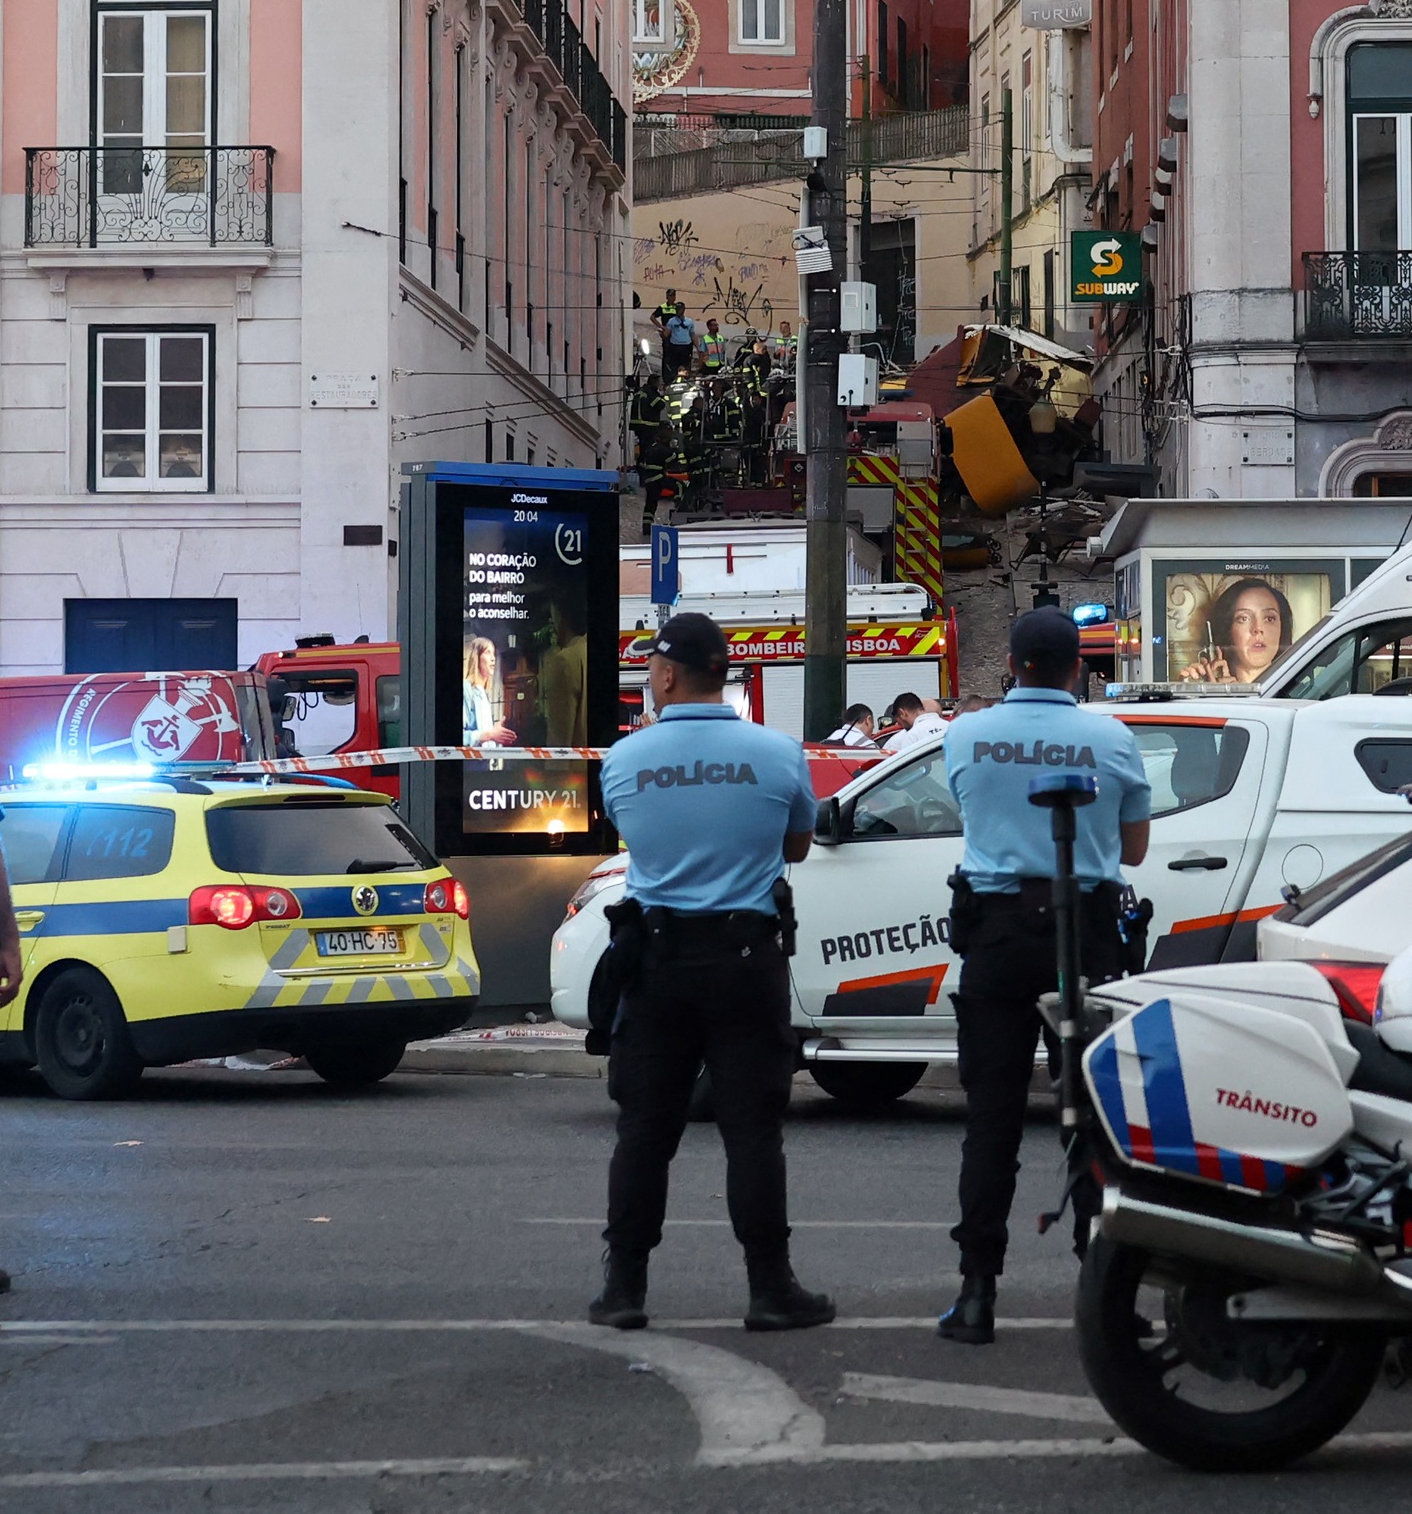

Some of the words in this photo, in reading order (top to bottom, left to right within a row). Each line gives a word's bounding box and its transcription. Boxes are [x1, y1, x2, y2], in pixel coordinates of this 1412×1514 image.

[1031, 6, 1083, 24] TURIM
[1075, 282, 1139, 295] SUBWAY
[511, 494, 548, 504] JCDecaux
[564, 529, 582, 552] 21
[469, 553, 484, 566] NO
[487, 552, 537, 569] CORAÇÃO
[659, 532, 671, 582] P
[469, 570, 484, 584] DO
[487, 571, 525, 584] BAIRRO
[469, 594, 490, 605] para
[492, 591, 525, 603] melhor
[469, 610, 476, 618] o
[477, 607, 530, 620] aconselhar.
[726, 641, 805, 656] BOMBEIR
[846, 638, 900, 652] ISBOA
[68, 688, 96, 747] REGIMENTO
[973, 740, 1096, 768] POLÍCIA
[637, 759, 757, 792] POLÍCIA
[469, 790, 556, 810] CENTURY
[821, 914, 950, 964] PROTEÇÃO
[1216, 1088, 1317, 1127] TRÂNSITO
